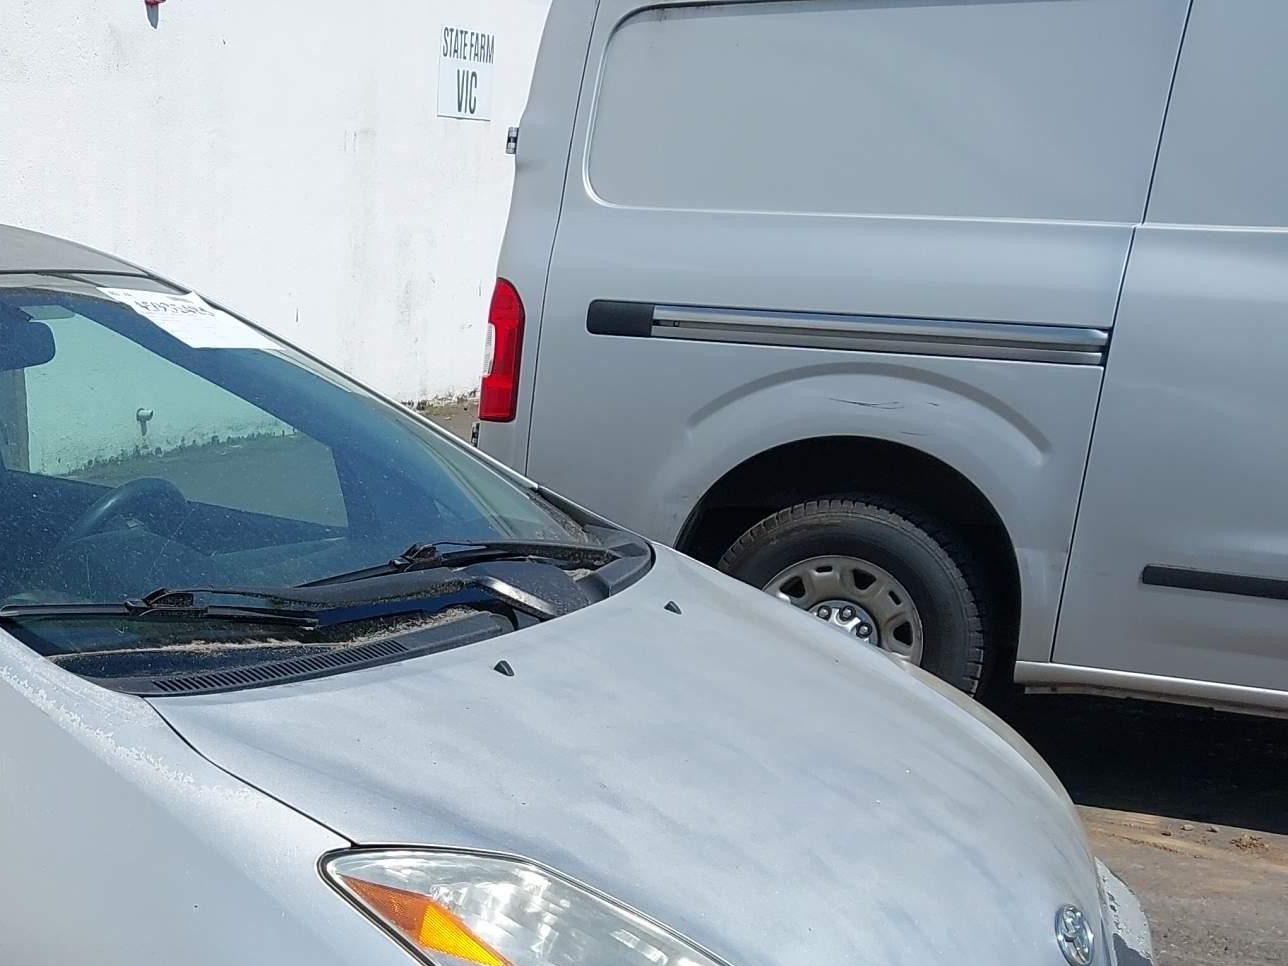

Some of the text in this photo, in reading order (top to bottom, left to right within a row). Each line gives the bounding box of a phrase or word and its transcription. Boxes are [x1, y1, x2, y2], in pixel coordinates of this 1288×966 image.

[442, 26, 495, 65] STATE FARM
[456, 68, 478, 115] VIC
